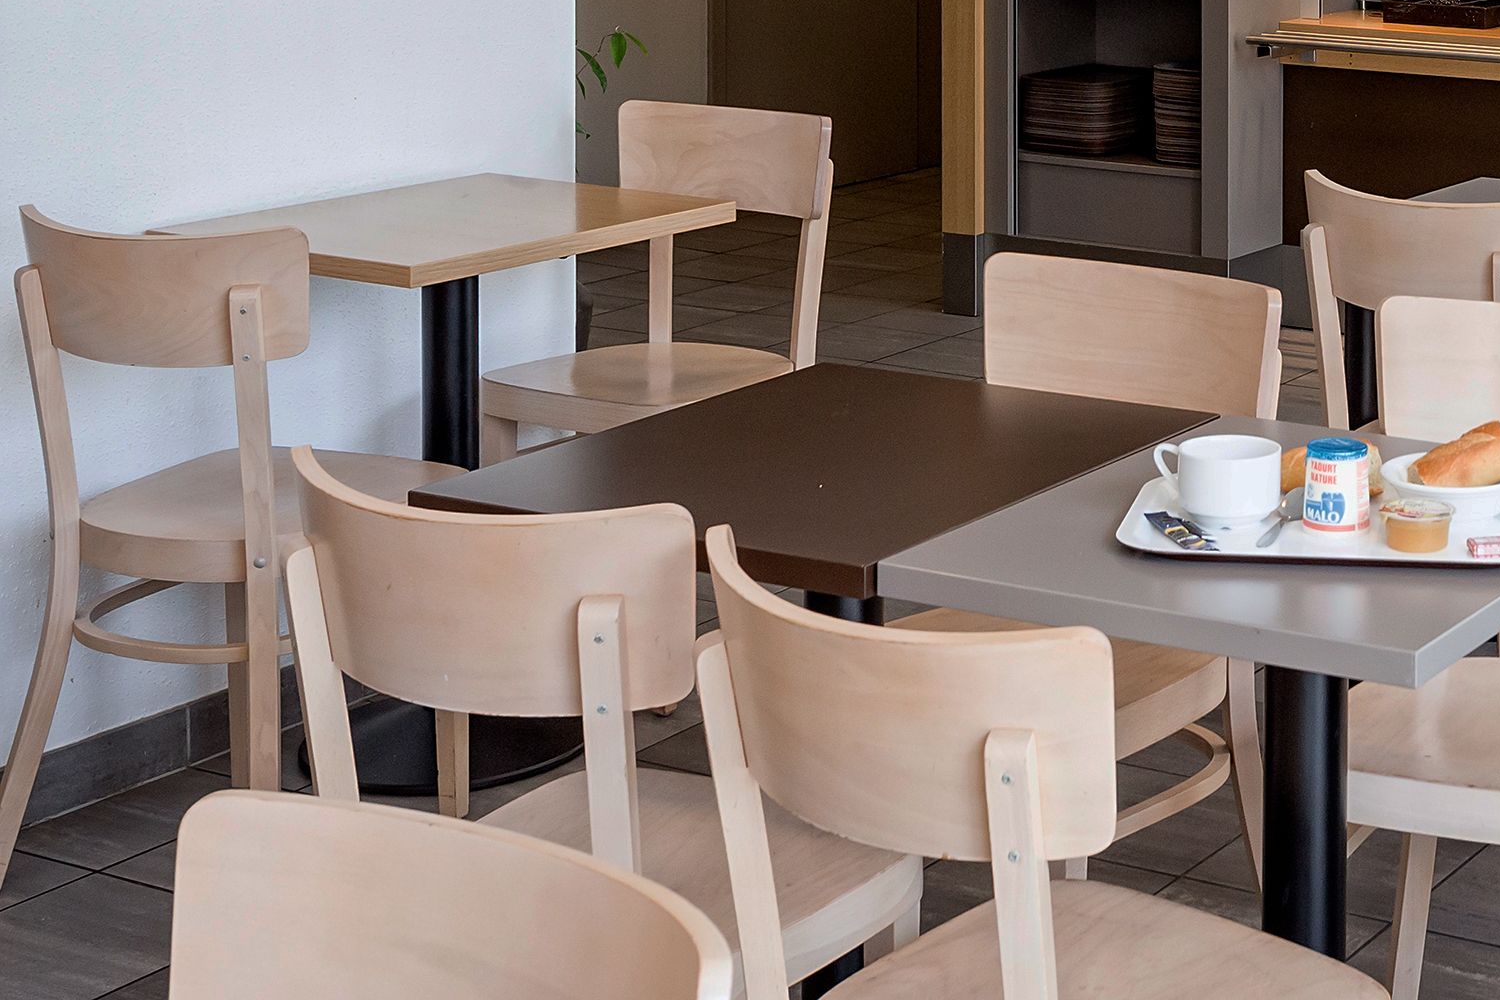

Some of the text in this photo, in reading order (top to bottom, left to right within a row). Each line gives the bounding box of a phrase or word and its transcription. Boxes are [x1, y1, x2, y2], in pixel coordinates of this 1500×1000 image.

[1310, 460, 1337, 473] YAOURT
[1310, 472, 1337, 485] NATURE
[1307, 506, 1340, 524] MALO
